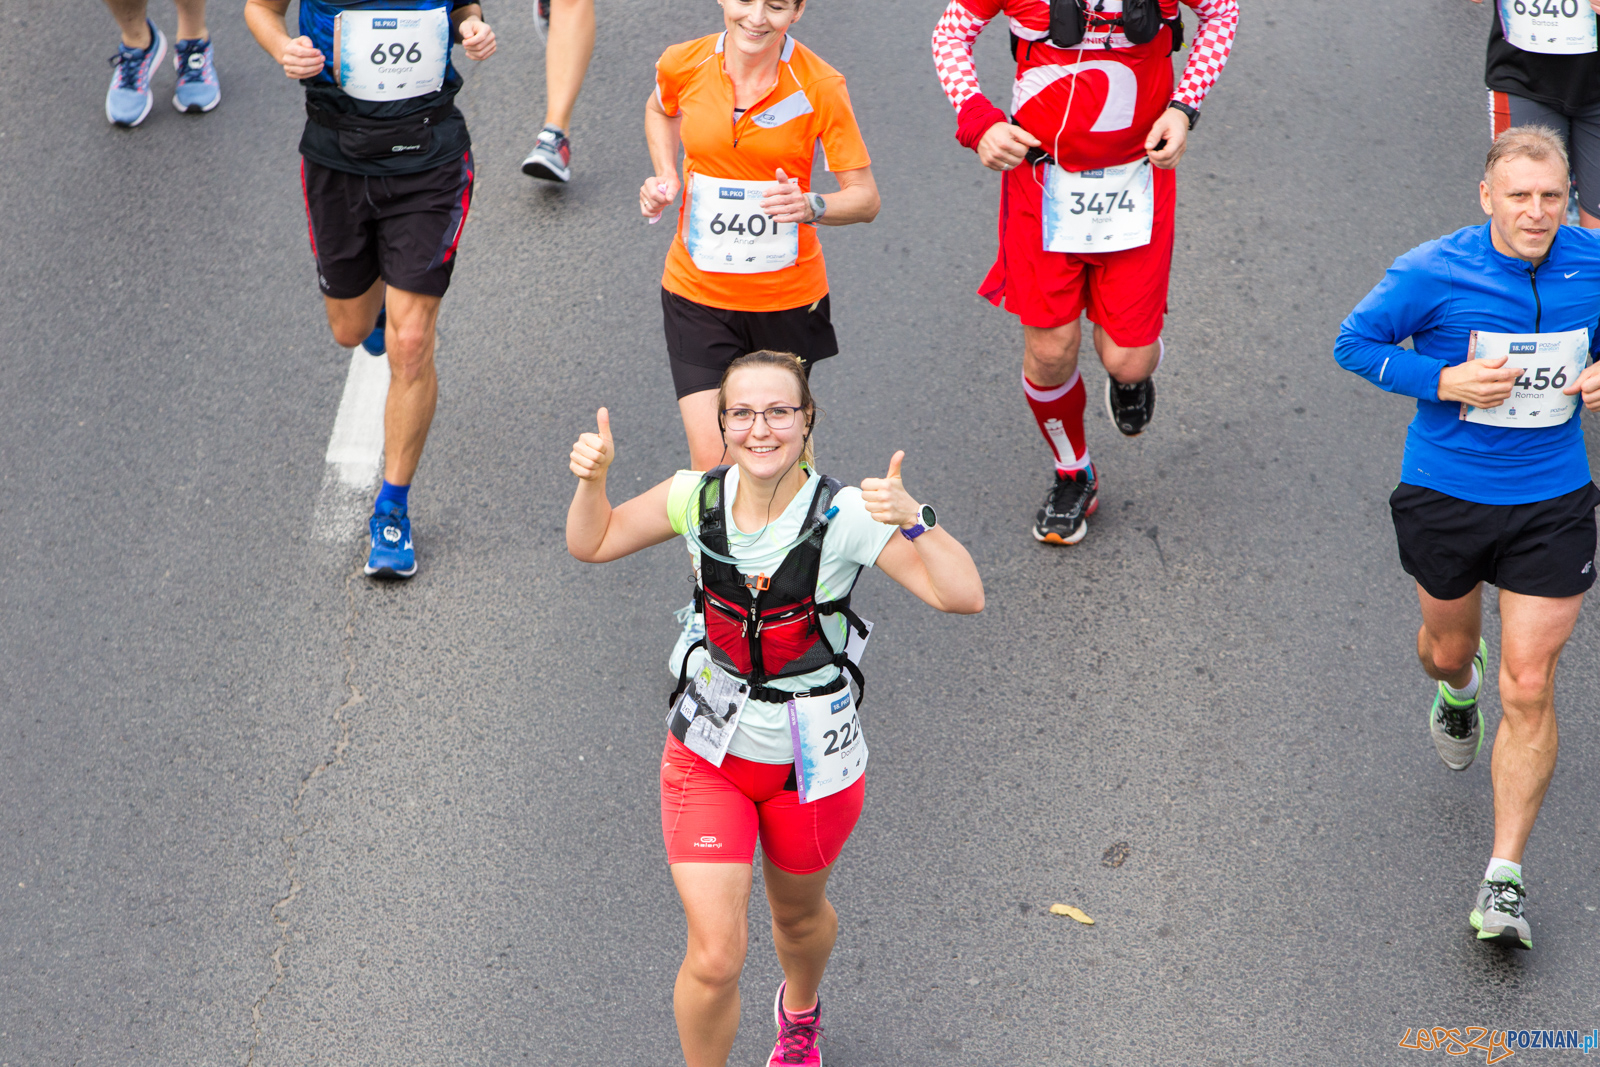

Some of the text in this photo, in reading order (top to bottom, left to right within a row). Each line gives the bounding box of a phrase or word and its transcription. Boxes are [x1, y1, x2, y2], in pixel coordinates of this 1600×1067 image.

[1513, 0, 1579, 18] 6340
[370, 42, 422, 65] 696
[378, 66, 413, 74] Grzegorz
[1070, 190, 1135, 215] 3474
[710, 213, 778, 236] 6401
[734, 237, 755, 245] Anna
[1514, 366, 1567, 391] 456
[1515, 391, 1545, 399] Roman
